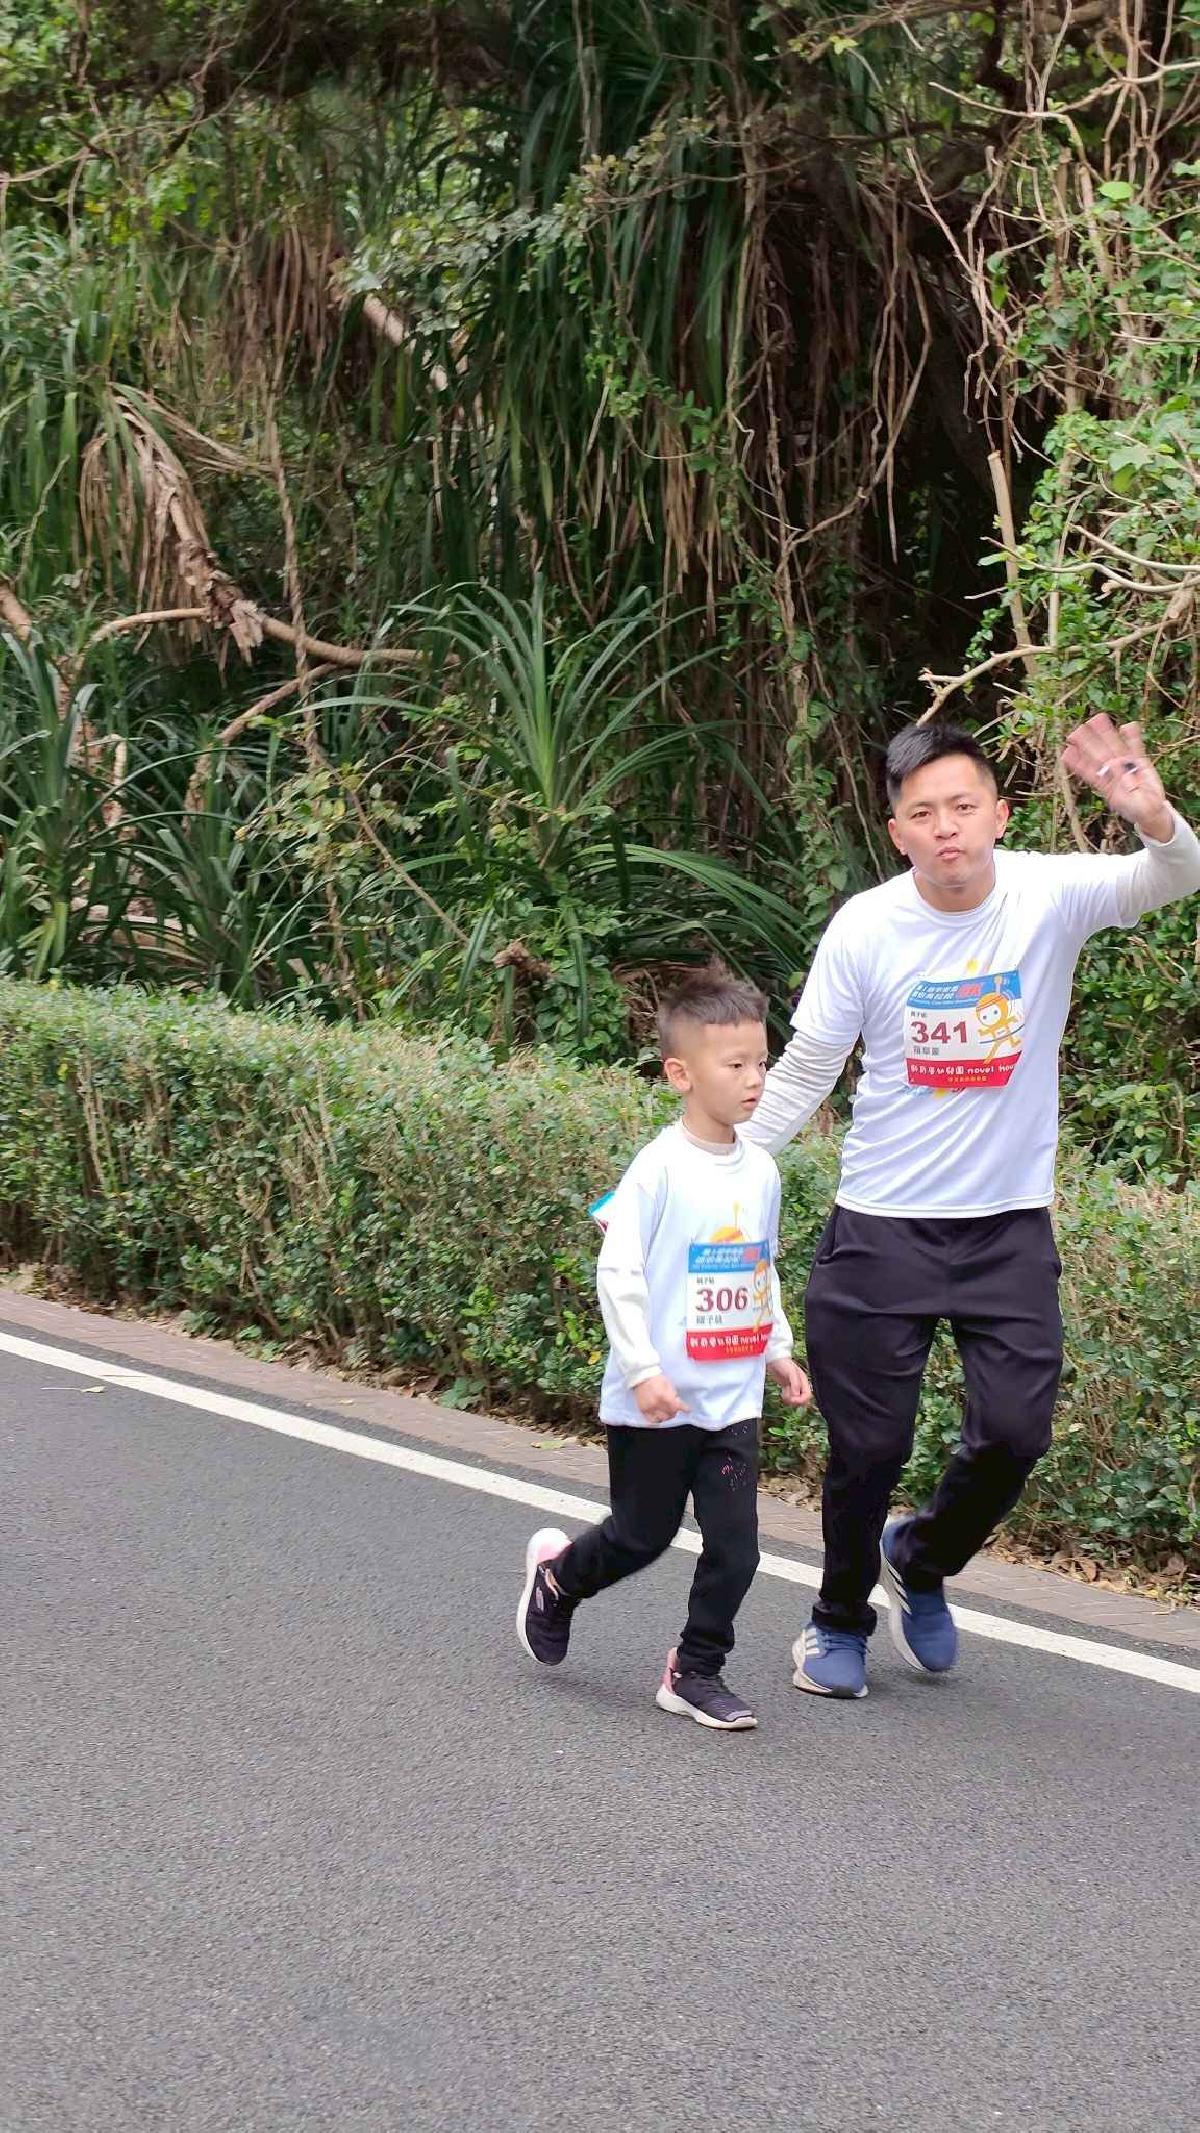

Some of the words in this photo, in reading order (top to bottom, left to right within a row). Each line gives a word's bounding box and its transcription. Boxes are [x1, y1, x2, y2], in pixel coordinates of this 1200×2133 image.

[910, 1021, 967, 1043] 341
[967, 1065, 994, 1075] novel
[695, 1287, 748, 1311] 306
